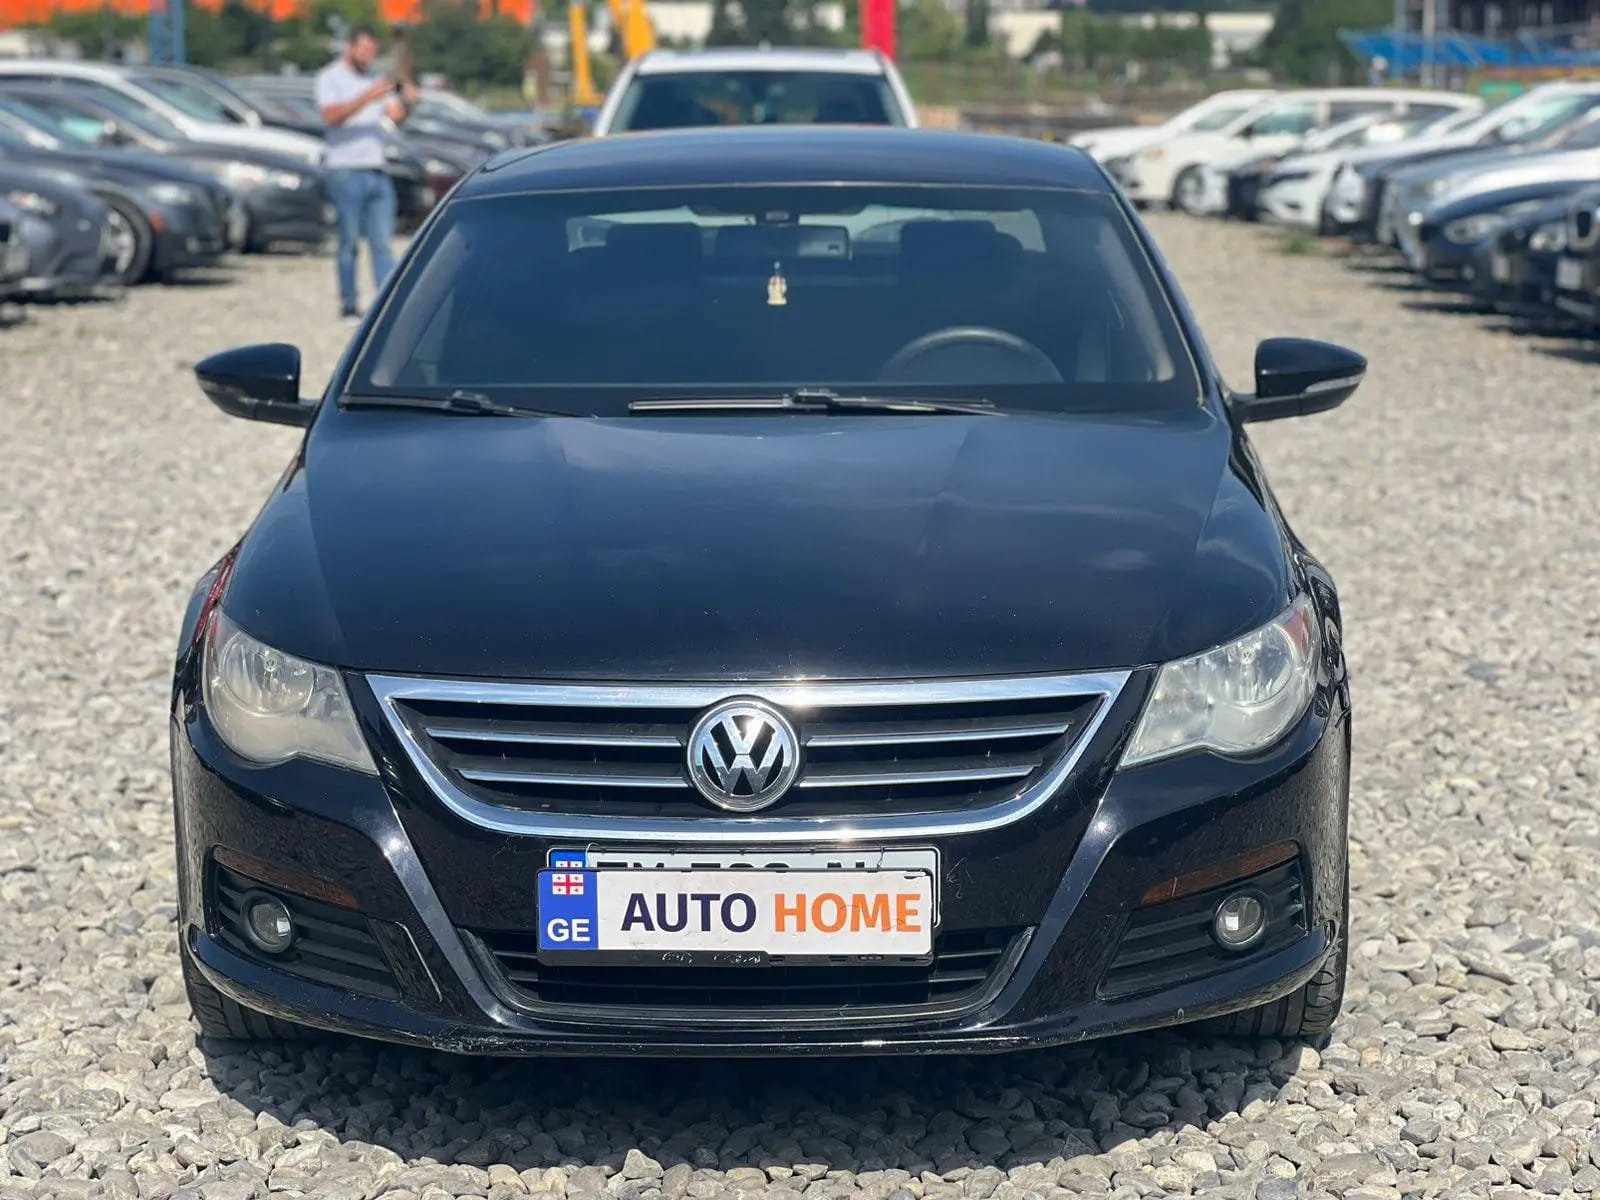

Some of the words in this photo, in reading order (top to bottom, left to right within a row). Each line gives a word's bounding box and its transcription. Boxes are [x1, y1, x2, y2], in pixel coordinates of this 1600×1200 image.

[690, 703, 797, 806] VW
[547, 918, 591, 942] GE
[620, 892, 757, 933] AUTO
[774, 892, 922, 933] HOME
